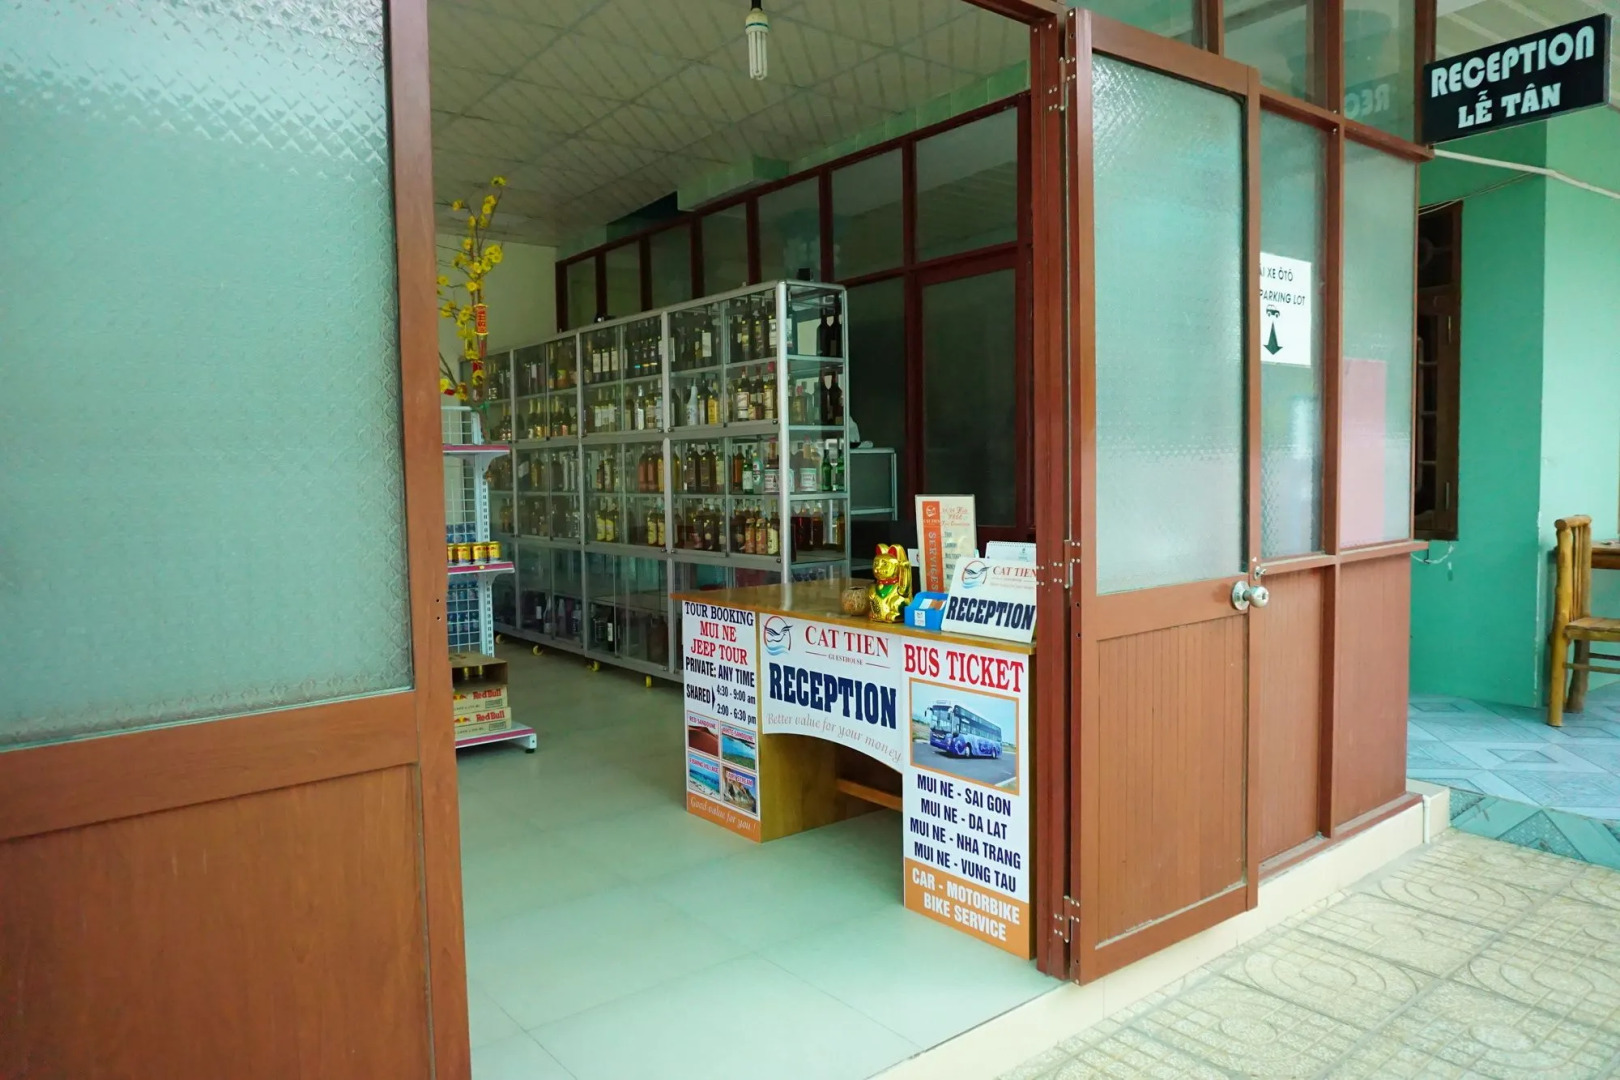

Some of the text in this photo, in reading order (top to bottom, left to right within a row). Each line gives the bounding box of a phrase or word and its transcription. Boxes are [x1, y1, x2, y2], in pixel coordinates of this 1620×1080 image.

[1431, 25, 1595, 98] RECEPTION
[1458, 82, 1561, 128] LỄ TÂN
[1267, 267, 1276, 279] XE
[1260, 289, 1305, 306] PARKING LOT
[992, 566, 1012, 576] CAT
[685, 602, 754, 626] TOUR BOOKING
[946, 596, 1036, 631] RECEPTION
[700, 620, 736, 642] MUI NE
[805, 625, 889, 658] CAT TIEN
[690, 638, 748, 666] JEEP TOUR
[828, 654, 863, 666] GUESTHOUSE
[904, 643, 1024, 692] BUS TICKET
[686, 656, 754, 688] PRIVATE: ANY TIME
[686, 684, 710, 704] SHARED
[716, 684, 728, 697] 4:30
[733, 688, 746, 702] 9:00
[747, 694, 756, 705] am
[769, 662, 896, 730] RECEPTION
[717, 703, 729, 716] 2:00
[734, 708, 746, 722] 6:30
[748, 713, 756, 725] pm
[767, 712, 902, 762] Better value for your money
[690, 796, 708, 810] Good
[726, 812, 736, 824] for
[917, 774, 936, 794] MUI
[940, 782, 954, 799] NE
[965, 788, 983, 808] SAI
[987, 795, 1011, 817] GON
[921, 798, 940, 818] MUI
[944, 806, 958, 824] NE
[969, 813, 983, 833] DA
[987, 819, 1007, 840] LAT
[910, 817, 929, 838] MUI
[932, 826, 946, 844] NE
[956, 833, 979, 856] NHA
[982, 842, 1021, 870] TRANG
[914, 842, 934, 862] MUI
[937, 850, 950, 869] NE
[961, 858, 990, 884] VUNG
[994, 870, 1016, 893] TAU
[912, 867, 936, 891] CAR
[947, 880, 1020, 925] MOTORBIKE
[924, 892, 1006, 942] BIKE SERVICE
